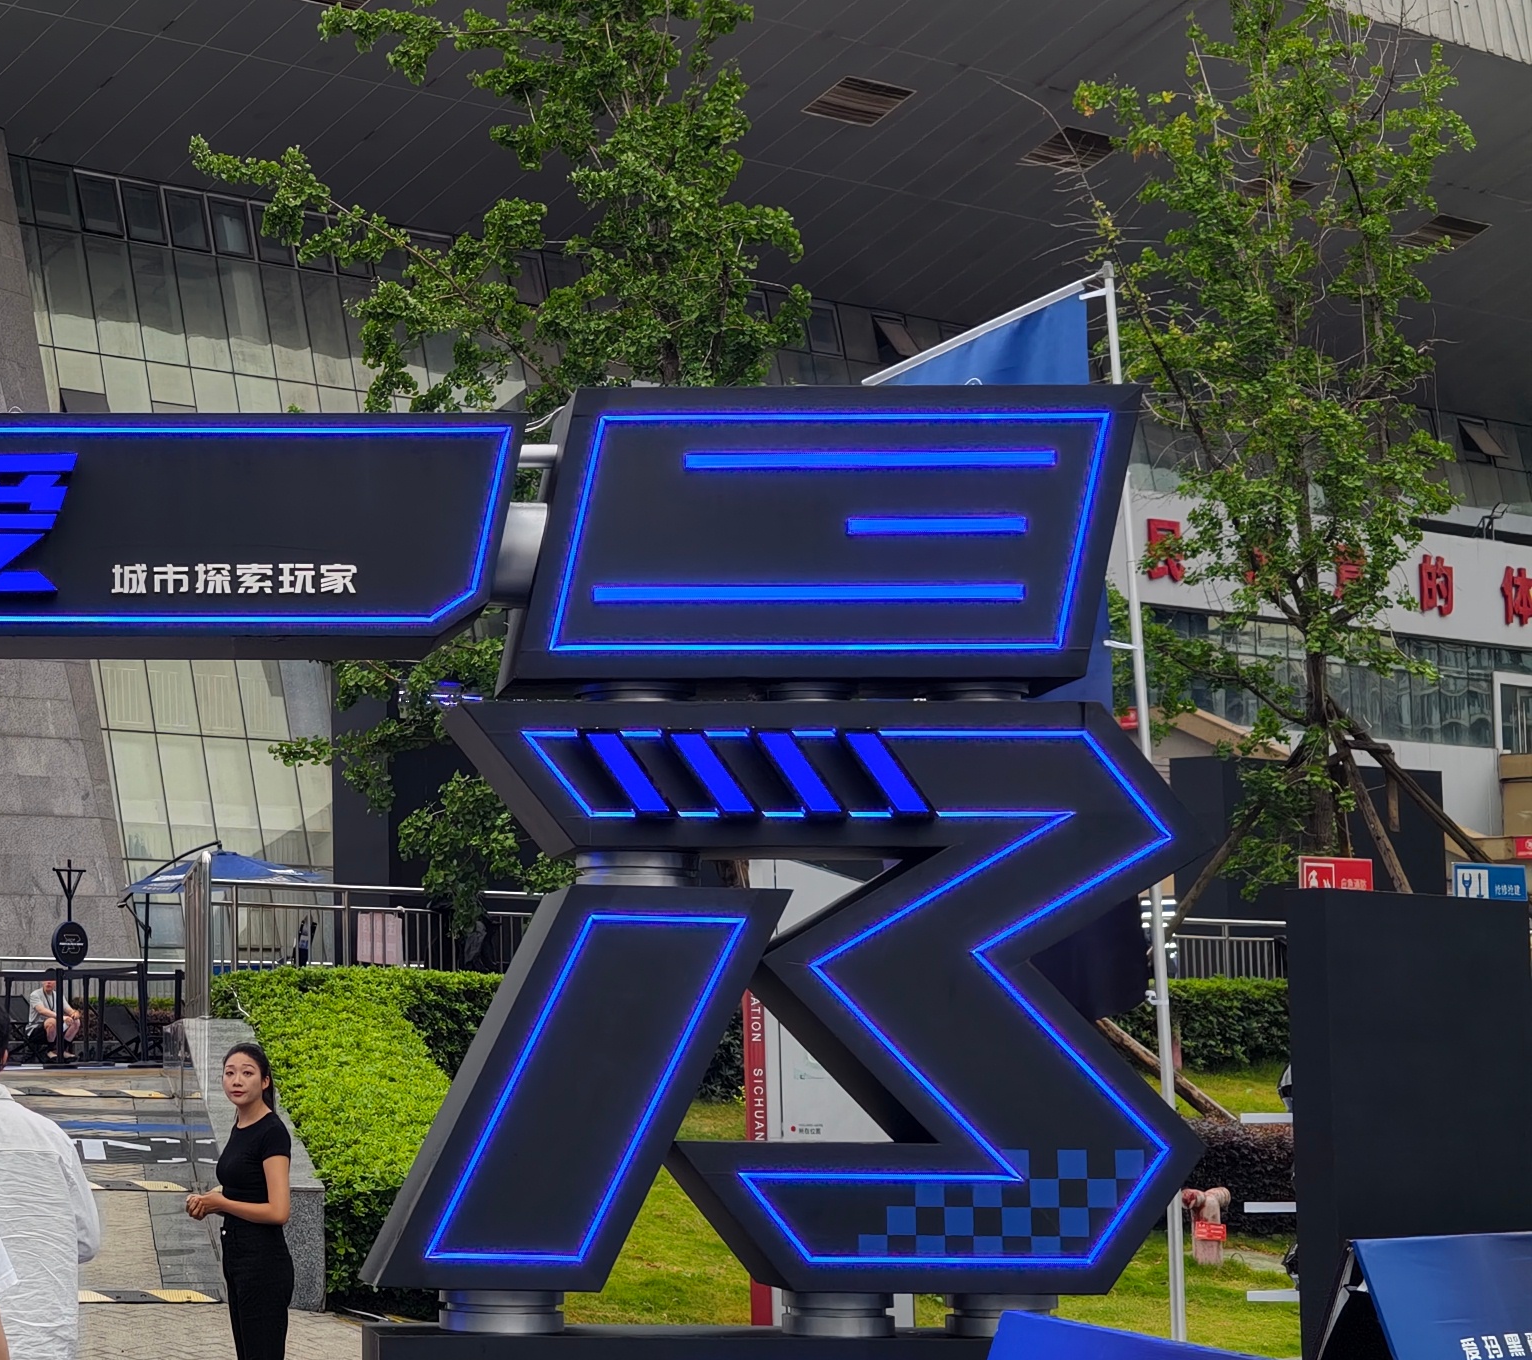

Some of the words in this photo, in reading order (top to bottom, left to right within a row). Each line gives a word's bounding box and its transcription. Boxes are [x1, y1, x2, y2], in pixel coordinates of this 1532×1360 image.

[111, 563, 358, 594] 城市探索玩家
[750, 992, 762, 1042] ATION
[753, 1068, 766, 1140] SICHUAN
